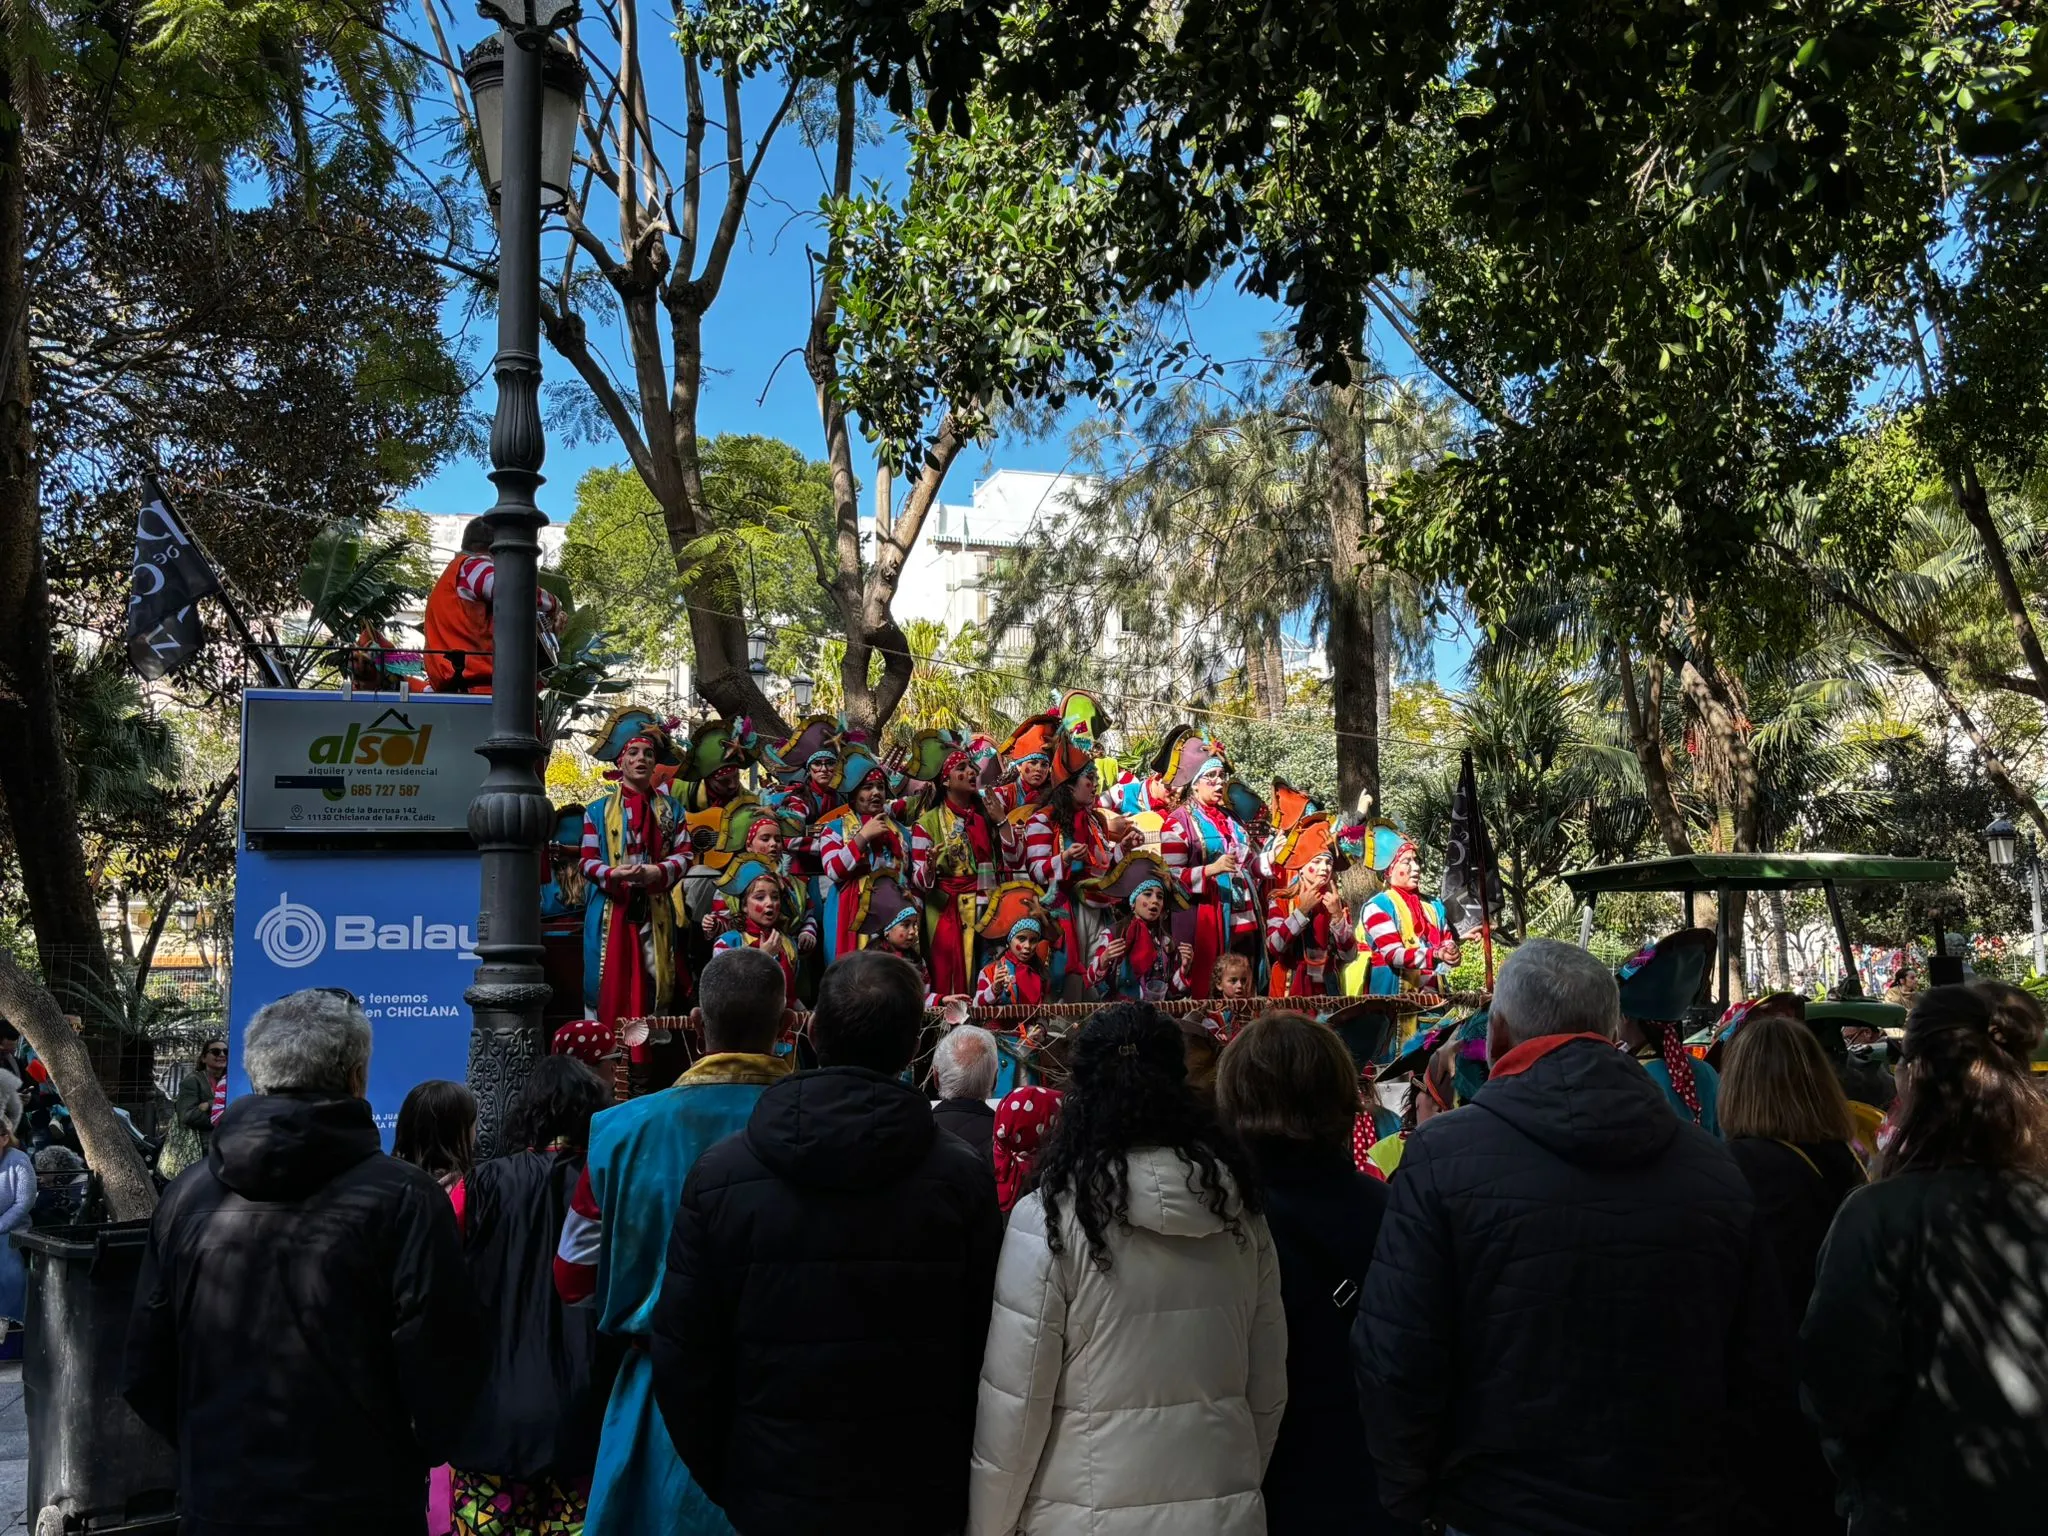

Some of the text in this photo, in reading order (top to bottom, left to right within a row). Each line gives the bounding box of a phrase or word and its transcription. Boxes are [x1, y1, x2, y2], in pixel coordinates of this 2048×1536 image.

[309, 723, 433, 767] alsol
[308, 767, 438, 776] alquiler y venta residencial
[351, 784, 420, 796] 685 727 587
[413, 813, 436, 821] Cádiz
[369, 993, 428, 1004] tenemos
[365, 1006, 459, 1017] en CHICLANA
